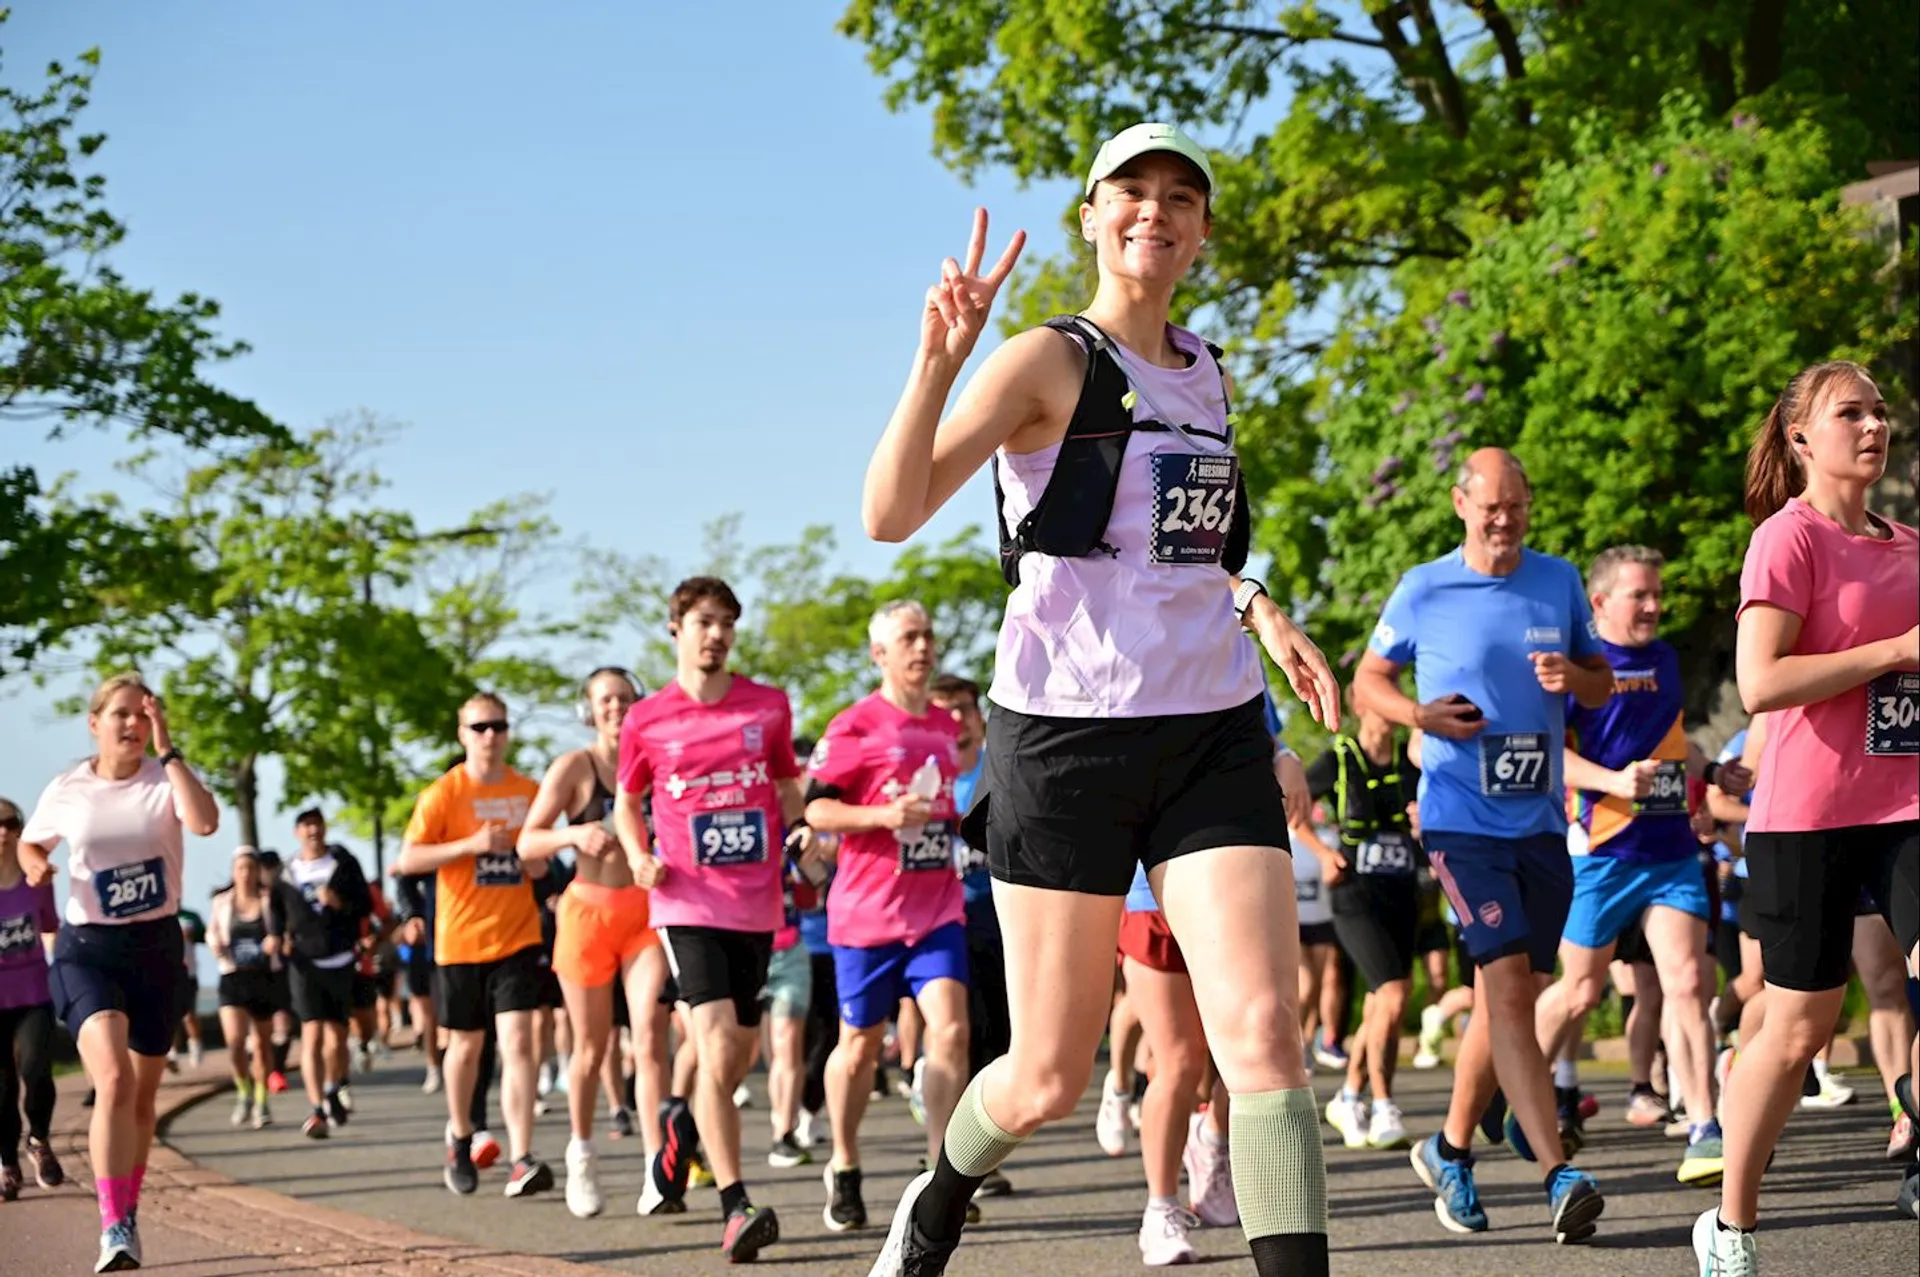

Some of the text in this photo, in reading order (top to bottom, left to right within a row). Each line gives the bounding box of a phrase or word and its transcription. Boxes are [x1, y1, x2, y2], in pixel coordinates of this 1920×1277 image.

[1494, 750, 1545, 783] 677
[701, 824, 757, 857] 935
[106, 872, 158, 908] 2871
